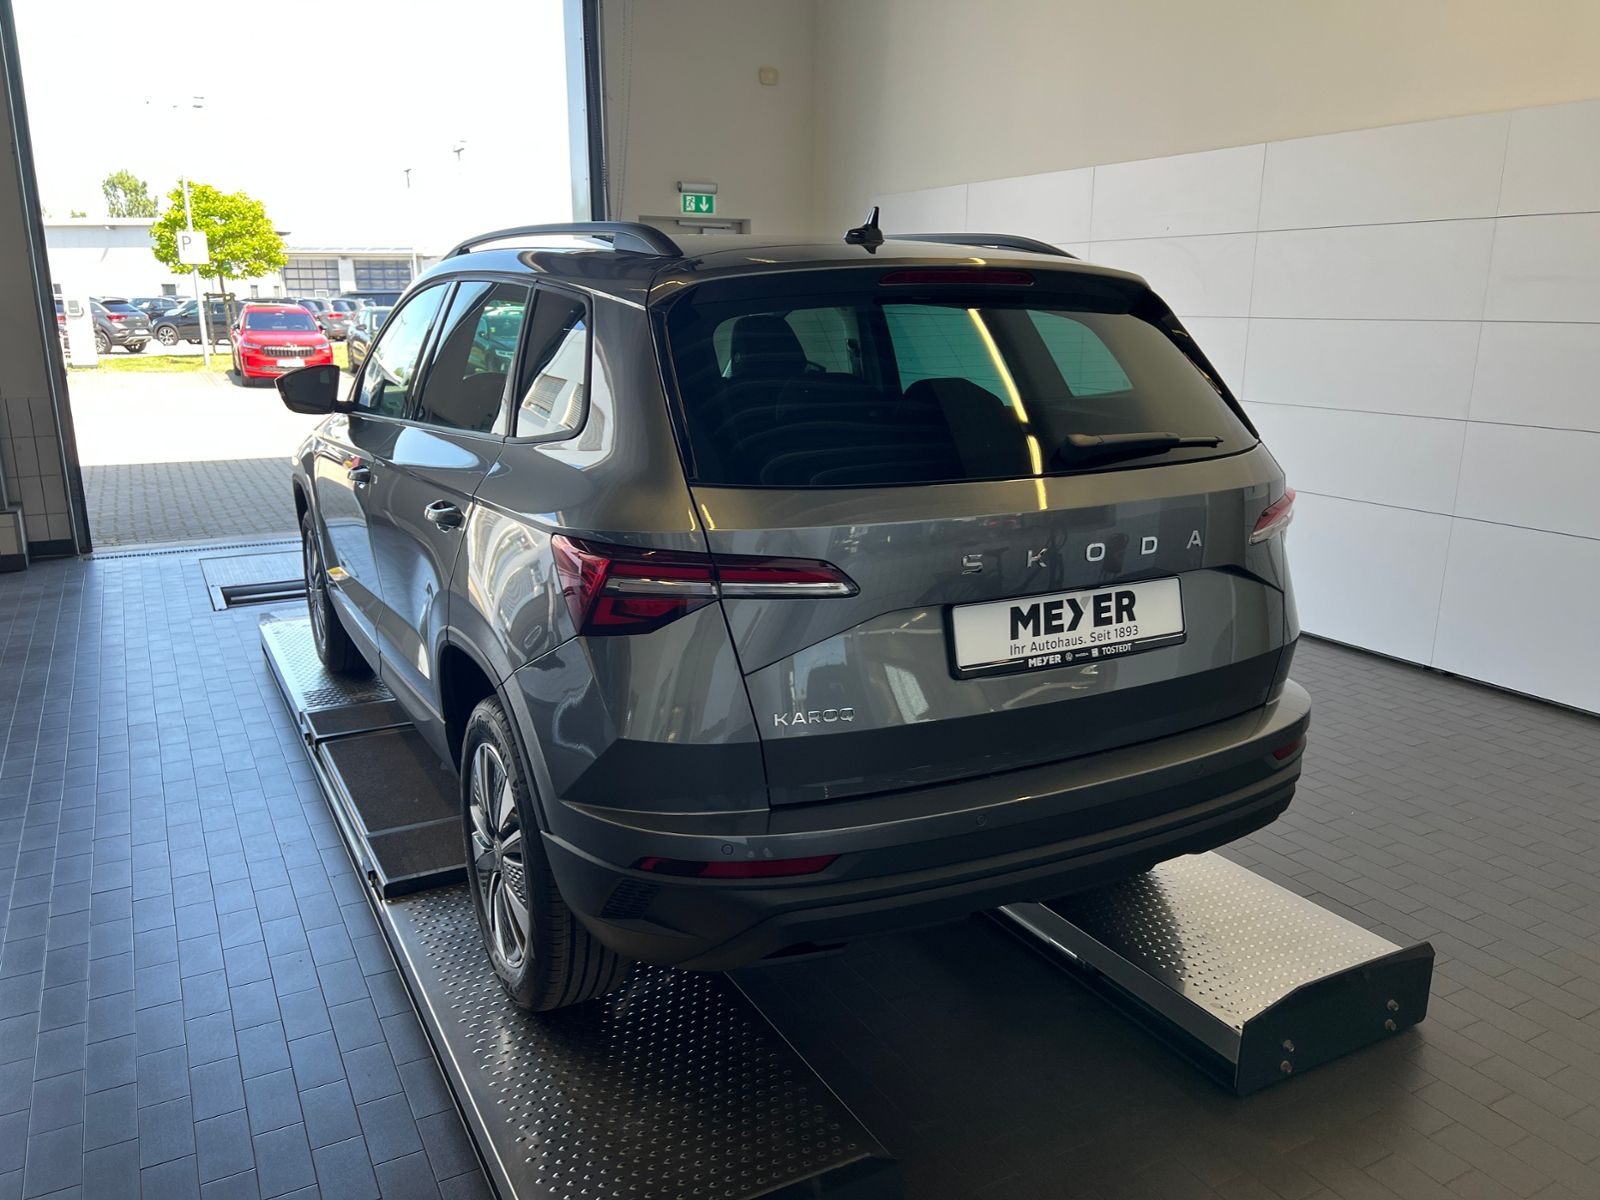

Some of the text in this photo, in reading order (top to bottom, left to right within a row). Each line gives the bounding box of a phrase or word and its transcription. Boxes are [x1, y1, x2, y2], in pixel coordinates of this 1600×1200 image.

[182, 235, 191, 251] P
[1010, 590, 1136, 640] MEYER
[1010, 625, 1139, 656] Ihr Autohaus. Seit 1893
[1028, 643, 1132, 668] MEYER TOSTEDT
[774, 707, 855, 727] KAROQ
